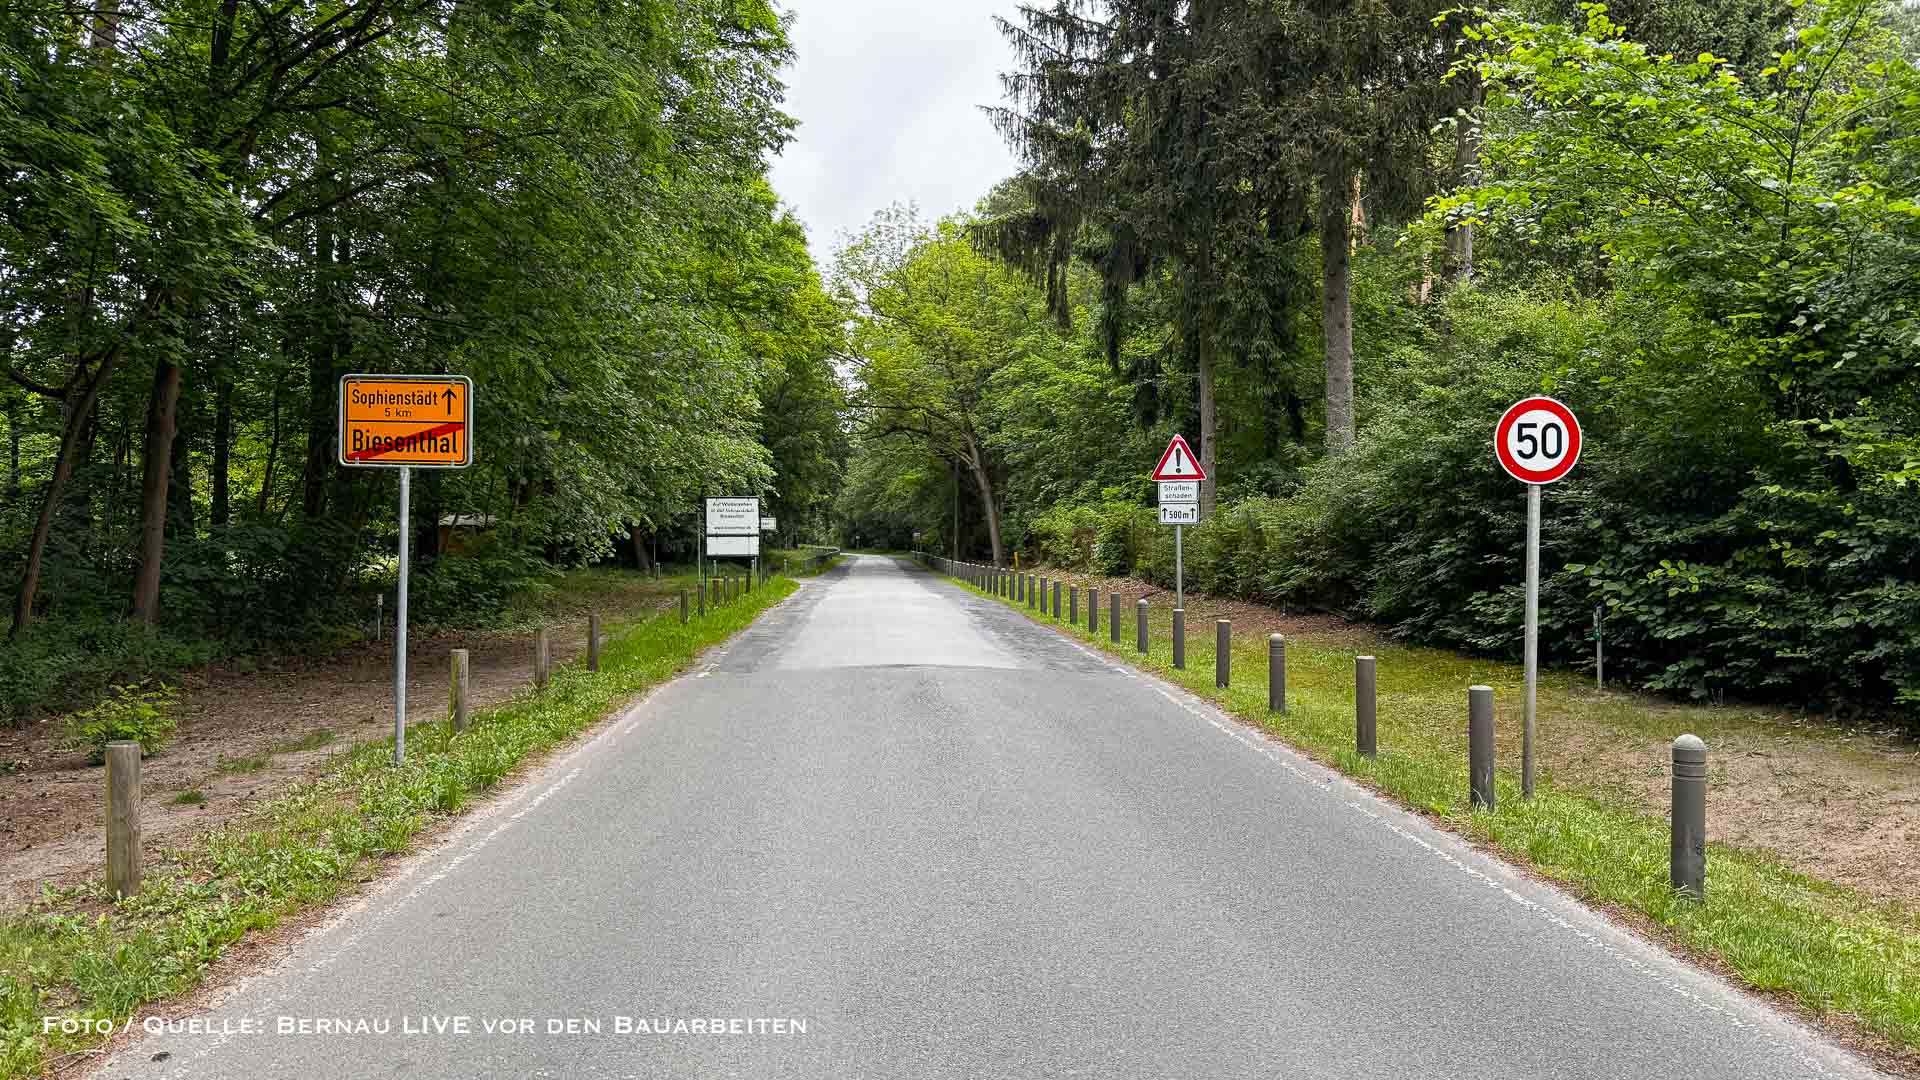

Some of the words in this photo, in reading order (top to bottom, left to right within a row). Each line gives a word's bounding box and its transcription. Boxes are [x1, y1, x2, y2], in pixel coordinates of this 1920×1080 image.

[351, 389, 438, 408] Sophienstädt
[384, 408, 391, 417] 5
[395, 408, 412, 417] km
[352, 429, 457, 453] Biesenthal
[1517, 422, 1562, 460] 50
